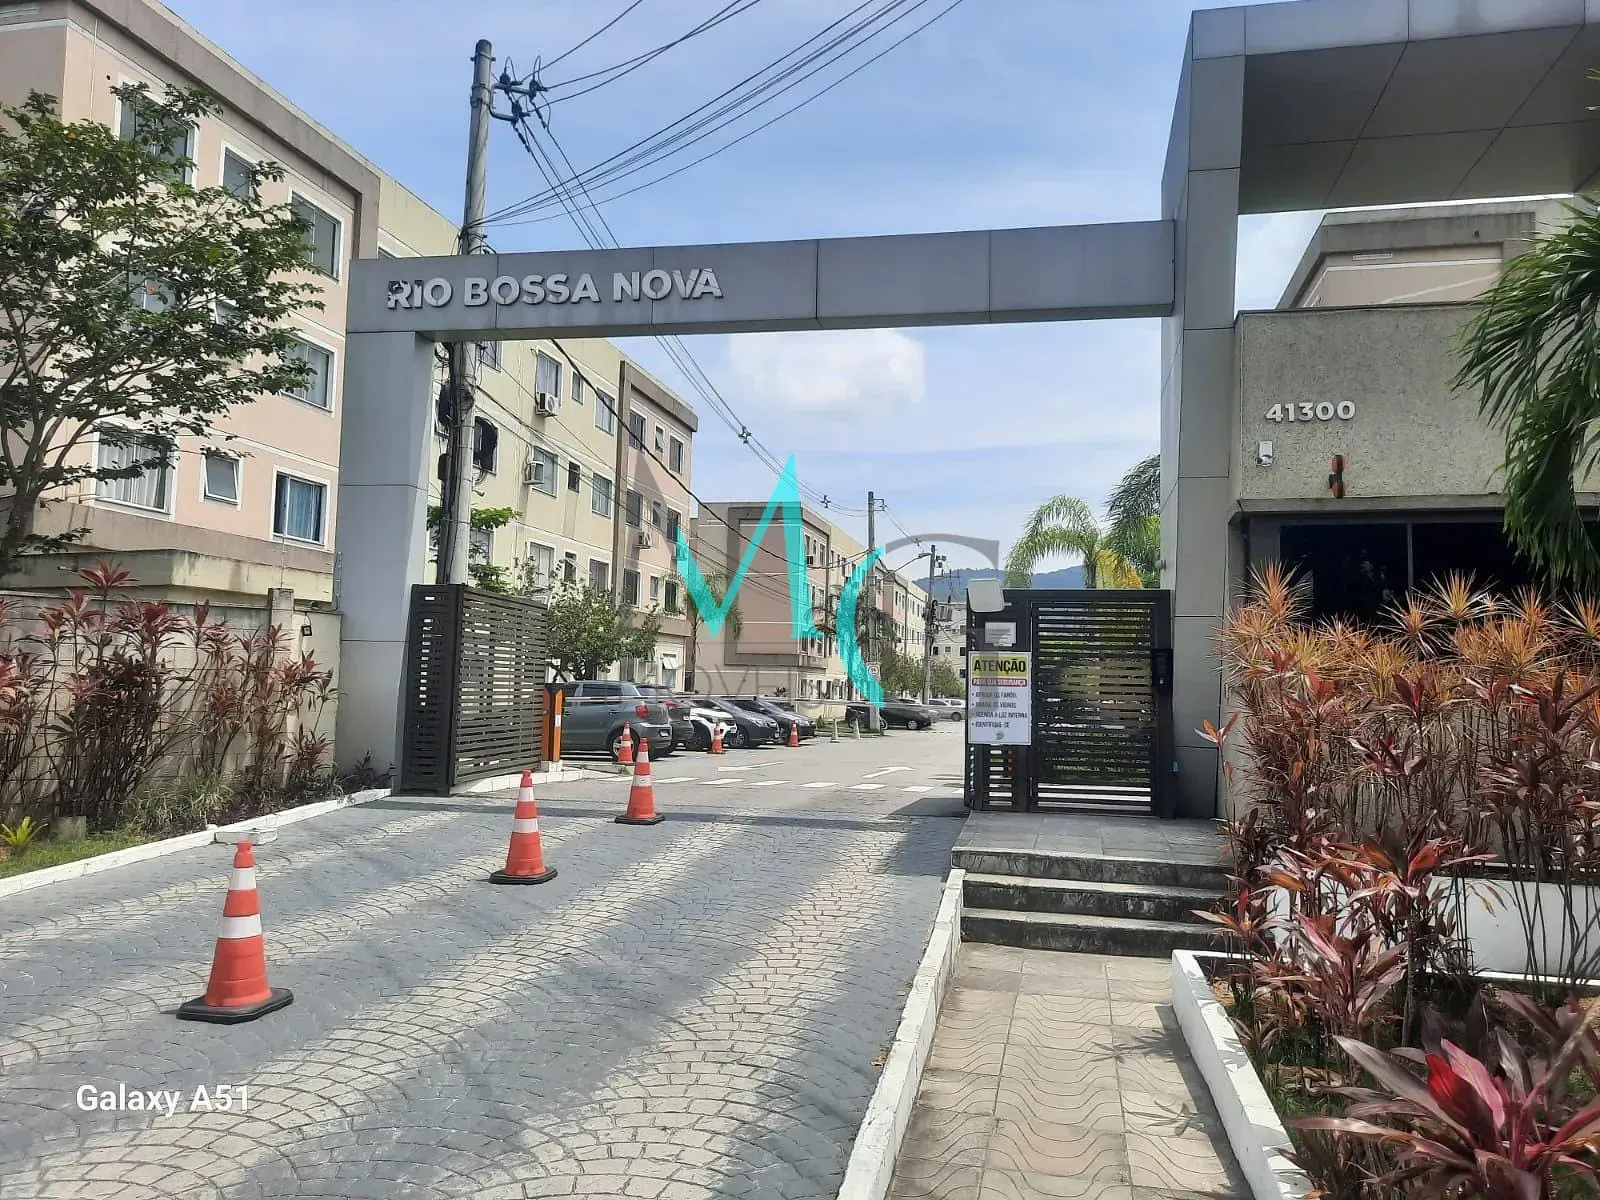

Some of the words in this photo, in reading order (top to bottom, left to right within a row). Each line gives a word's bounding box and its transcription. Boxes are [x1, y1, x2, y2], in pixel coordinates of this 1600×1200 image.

[387, 277, 453, 309] RIO
[463, 272, 601, 306] BOSSA
[612, 267, 724, 302] NOVA
[1265, 400, 1356, 422] 41300
[973, 658, 1026, 674] ATENÇÃO
